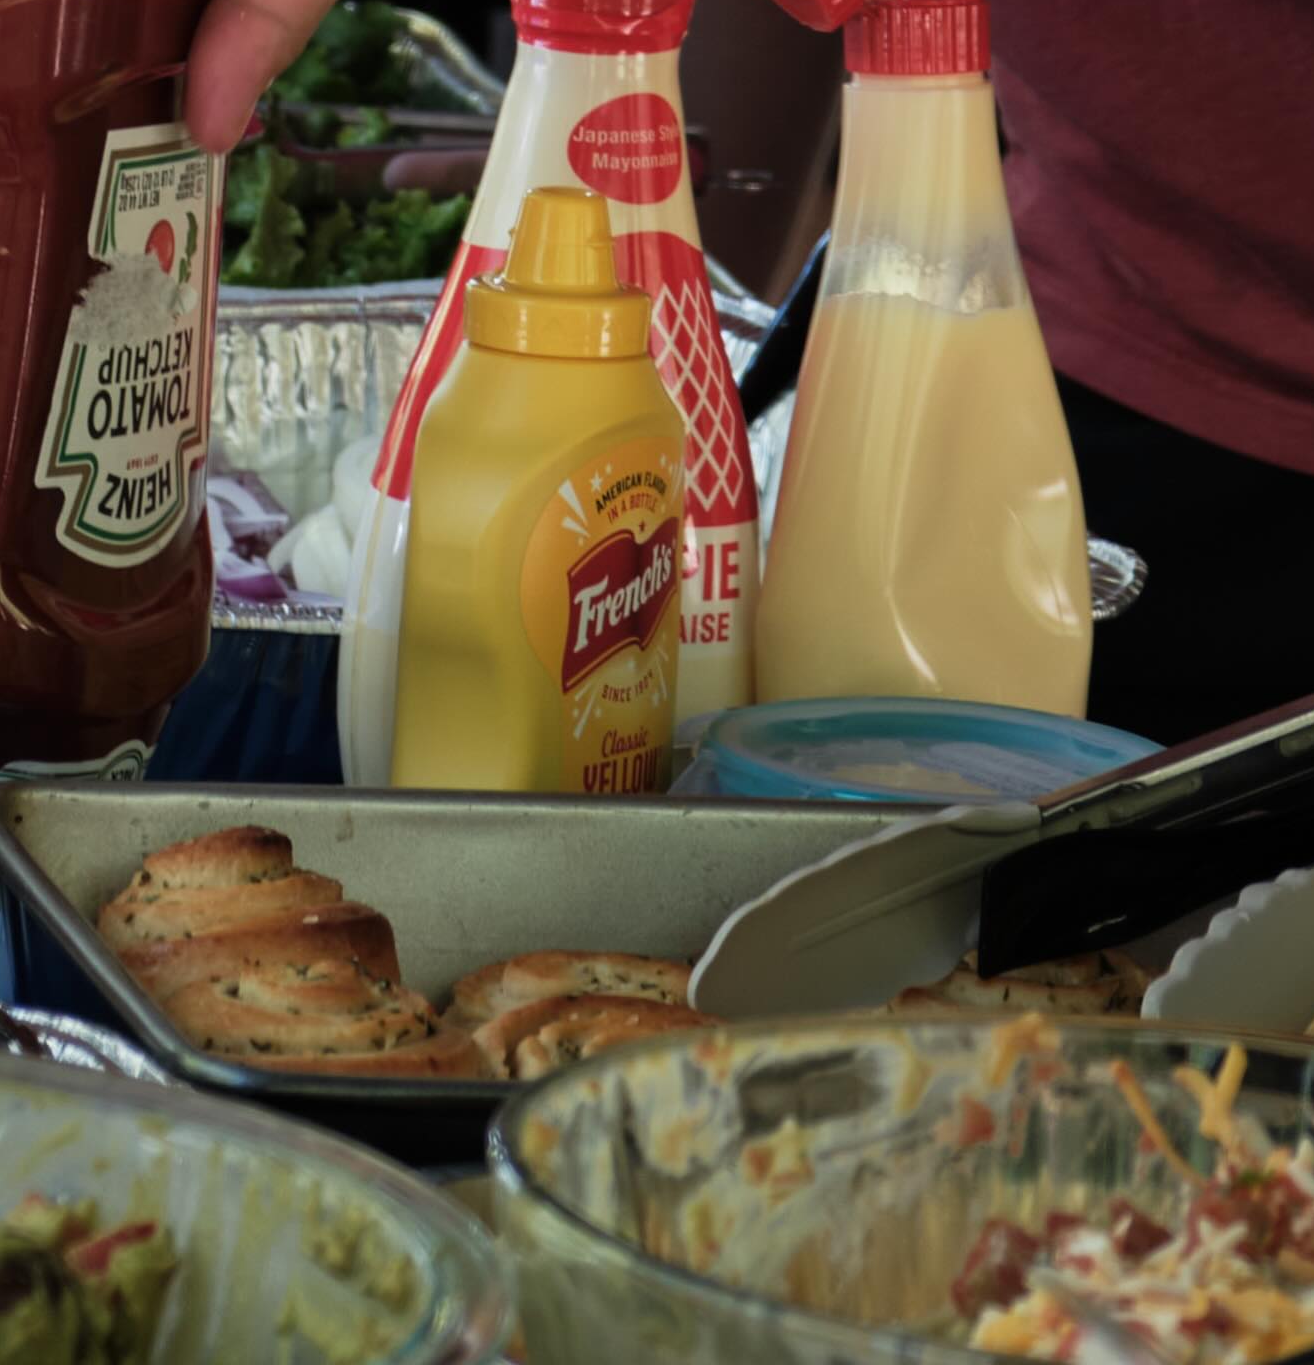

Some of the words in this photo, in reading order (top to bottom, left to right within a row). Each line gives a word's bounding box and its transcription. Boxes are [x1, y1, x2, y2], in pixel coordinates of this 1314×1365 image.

[572, 125, 656, 148] Japanese
[97, 328, 193, 386] KETCHUP
[87, 383, 191, 440] TOMATO
[97, 459, 173, 520] HEINZ
[595, 472, 642, 514] AMERICAN
[607, 505, 618, 524] IN
[621, 498, 628, 514] A
[573, 543, 672, 654] French's
[602, 684, 632, 703] SINCE
[601, 725, 649, 758] Classic
